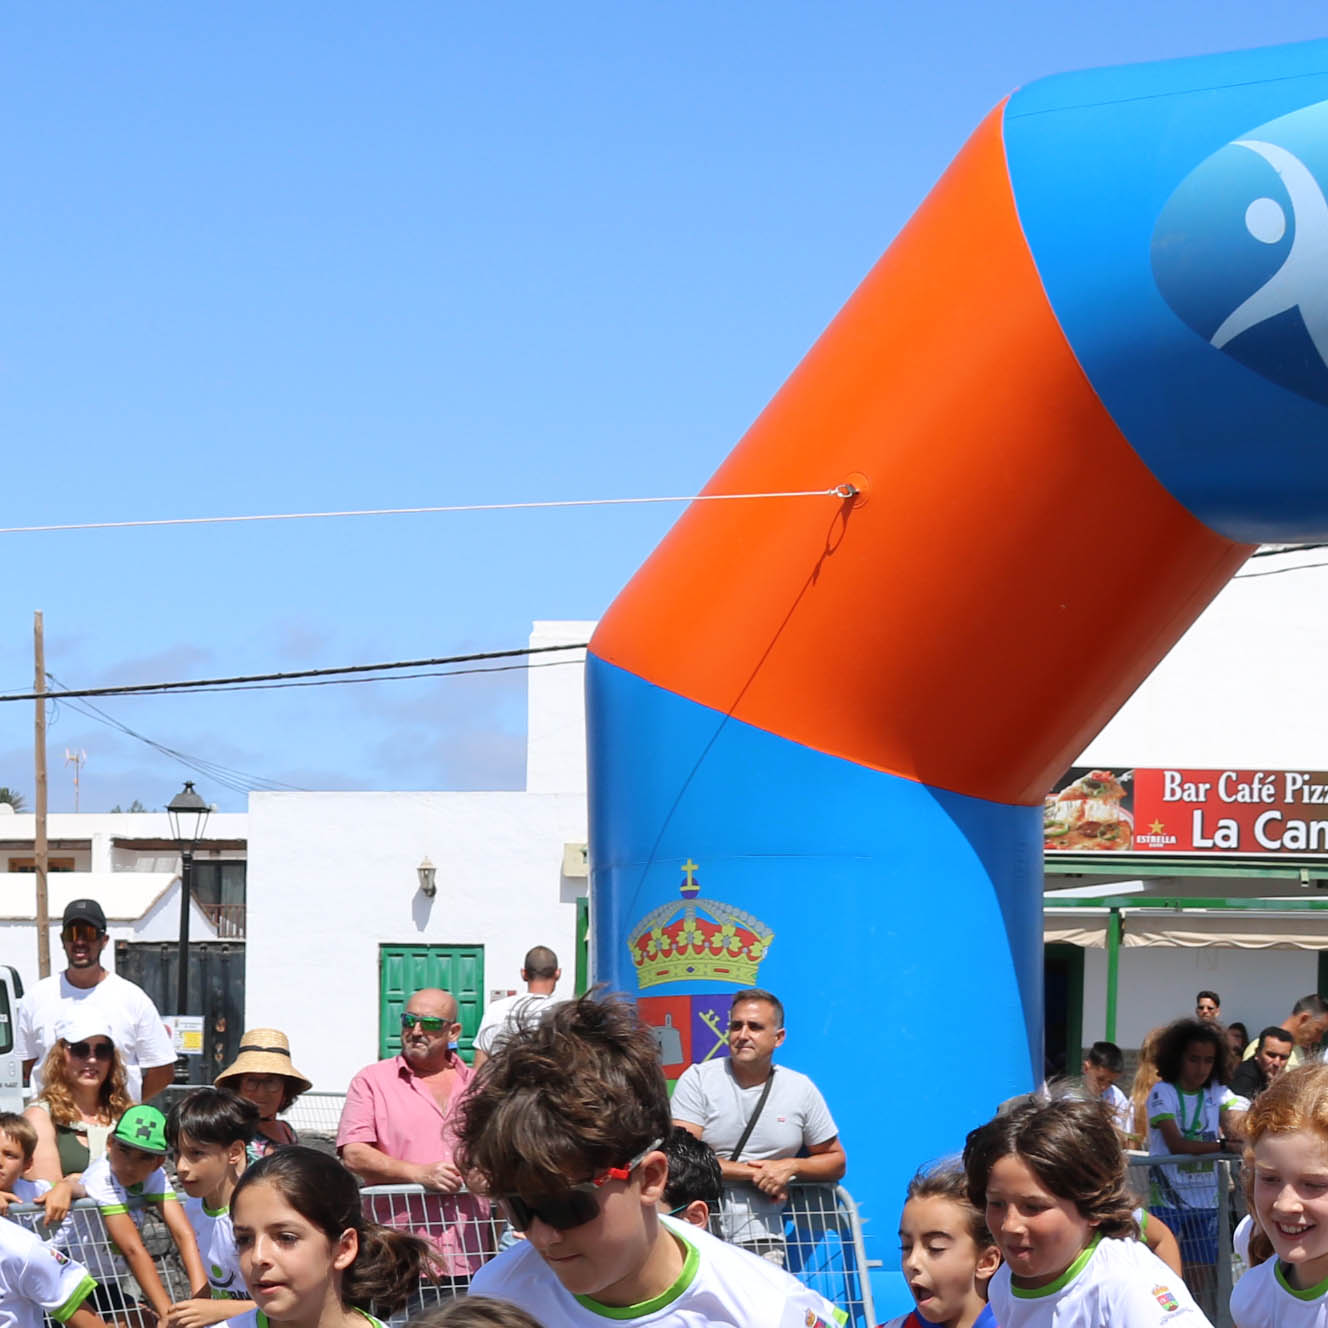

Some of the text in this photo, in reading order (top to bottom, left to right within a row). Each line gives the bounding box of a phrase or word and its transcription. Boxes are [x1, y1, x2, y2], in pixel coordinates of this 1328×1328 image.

[1163, 771, 1211, 802] Bar
[1218, 771, 1277, 804] Café
[1136, 834, 1177, 845] ESTRELLA
[1192, 809, 1239, 849] La
